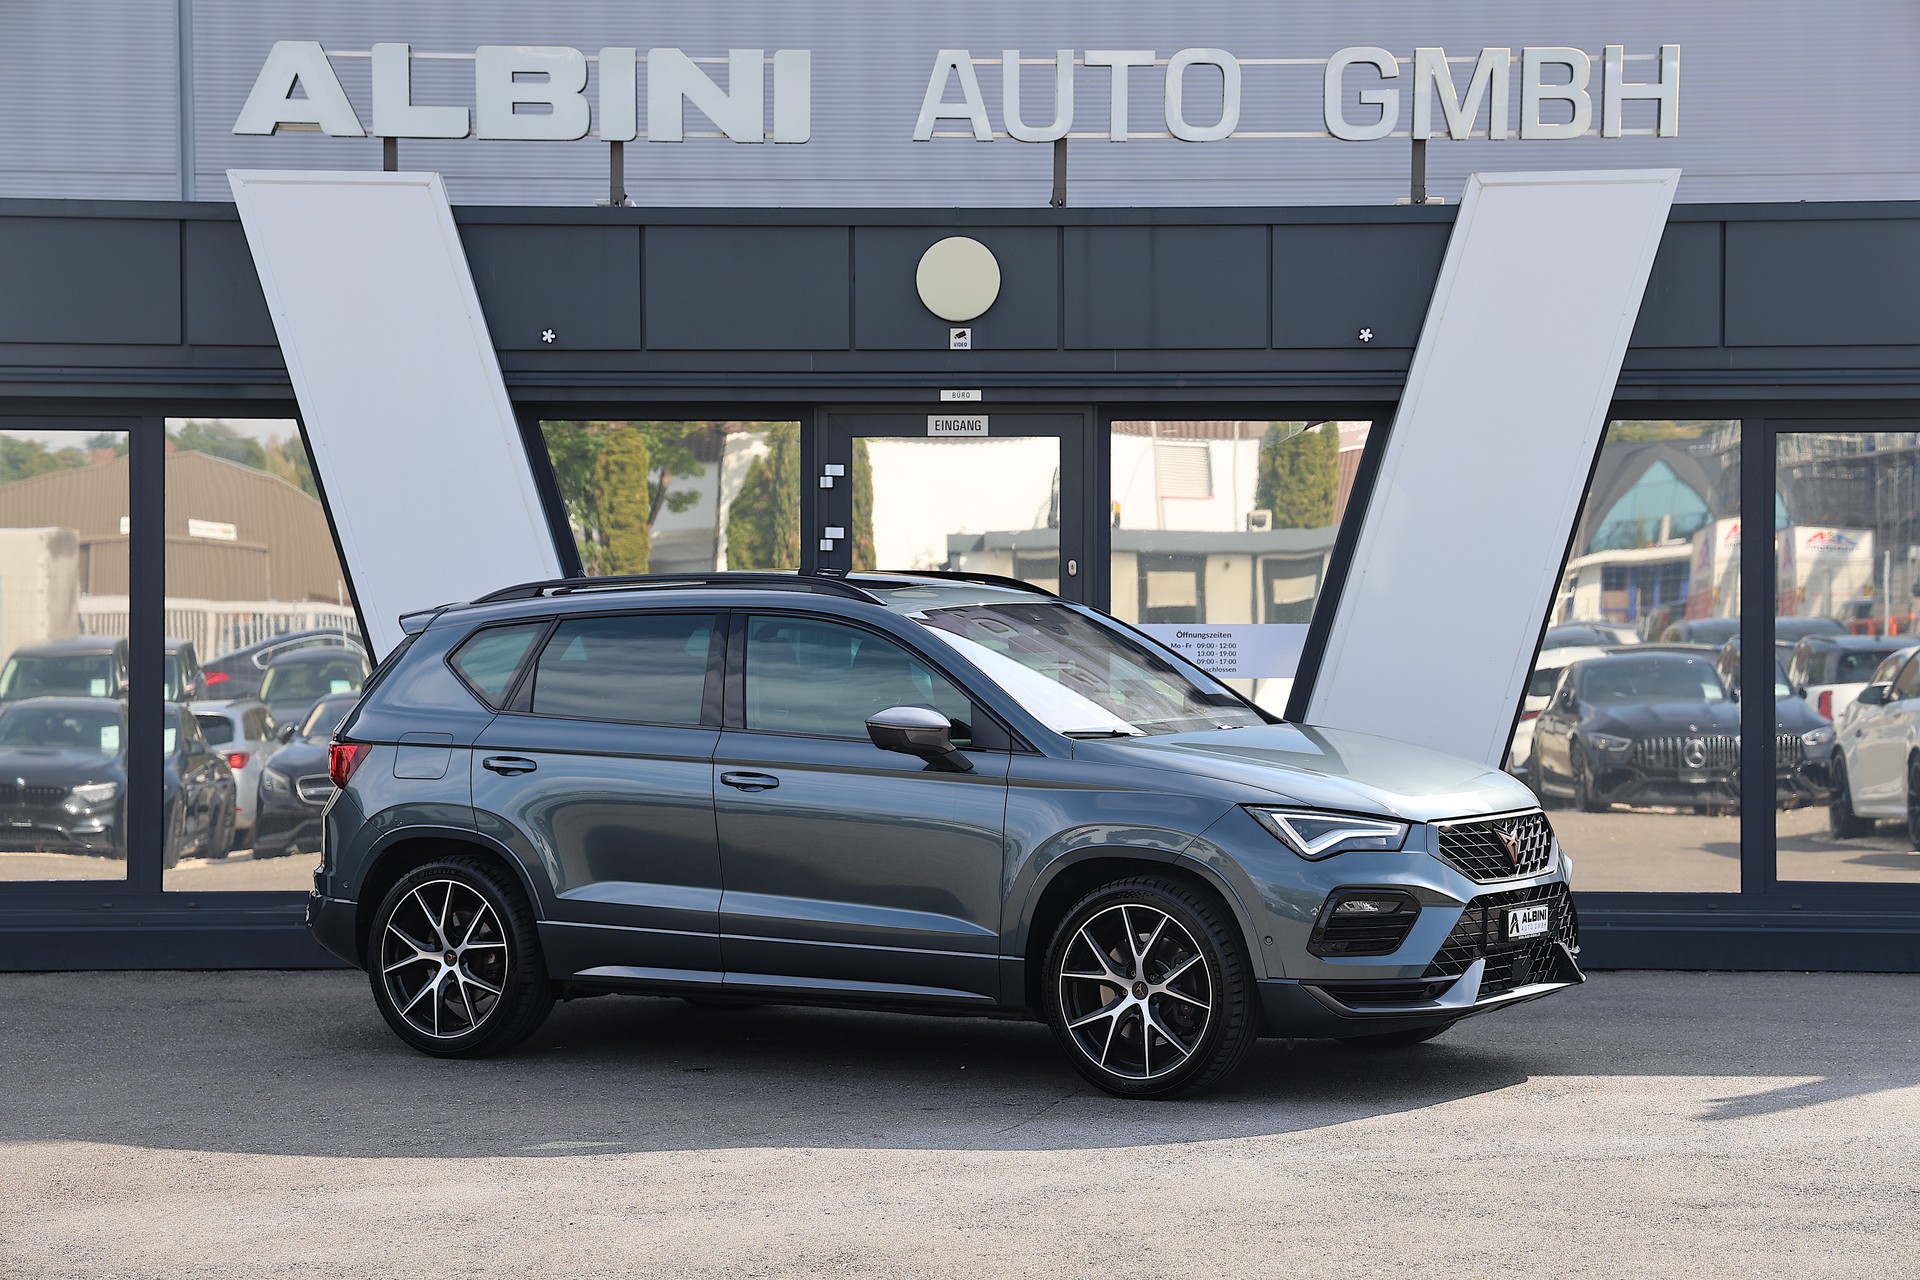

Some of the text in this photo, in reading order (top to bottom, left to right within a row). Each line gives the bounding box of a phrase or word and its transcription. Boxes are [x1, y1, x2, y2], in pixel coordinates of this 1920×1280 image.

[232, 40, 1681, 144] ALBINI AUTO GMBH
[935, 420, 982, 432] EINGANG
[1176, 630, 1232, 640] Öffnungszeiten
[1522, 909, 1547, 924] ALBINI
